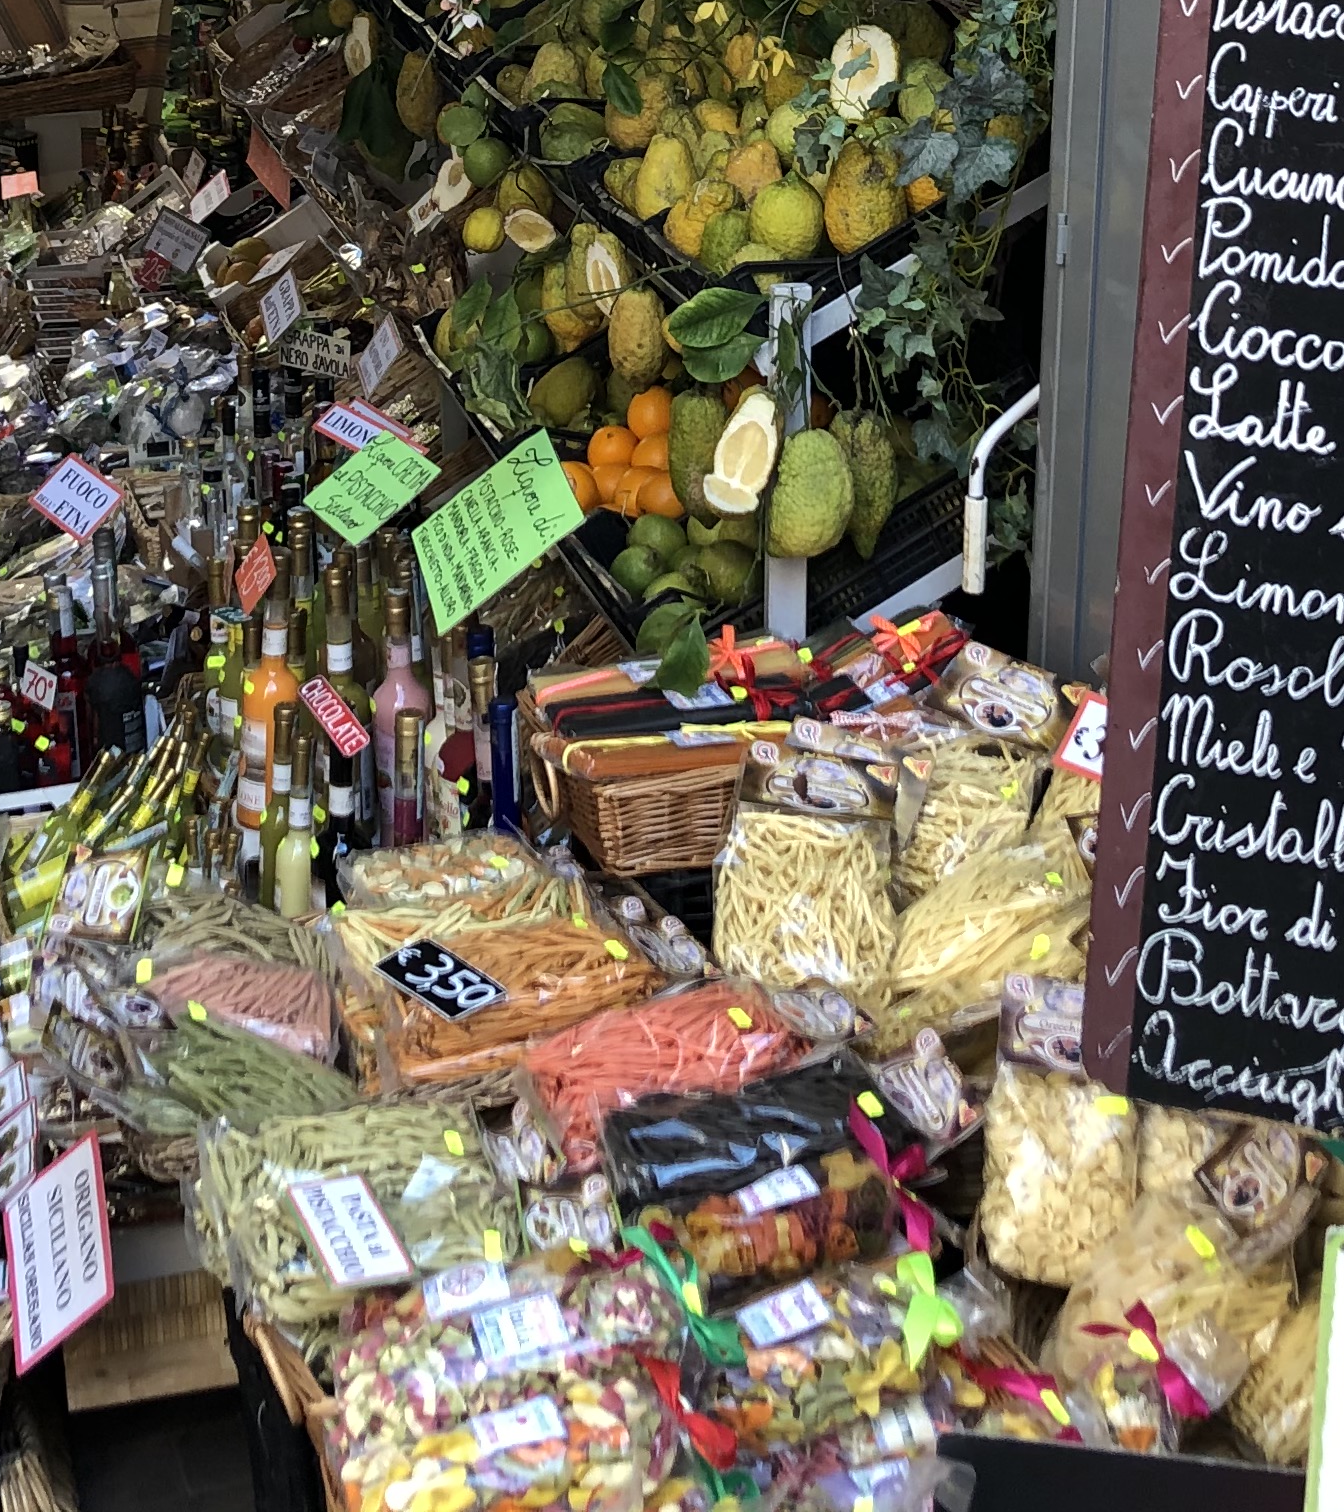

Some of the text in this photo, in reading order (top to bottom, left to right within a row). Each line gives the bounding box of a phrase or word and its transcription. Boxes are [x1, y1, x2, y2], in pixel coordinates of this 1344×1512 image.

[1206, 43, 1340, 138] Capperi
[278, 278, 296, 322] GRAPPA
[280, 346, 309, 367] NERO
[284, 330, 330, 354] GRAPPA
[1188, 362, 1337, 455] Latte
[60, 467, 109, 509] FUOCO
[392, 456, 432, 492] CREMA
[1184, 449, 1323, 534] Vino
[53, 499, 91, 535] ETNA
[25, 667, 54, 702] 70°
[300, 677, 368, 756] CHOCOLATE
[1161, 692, 1283, 781] Miele
[1294, 748, 1317, 784] e
[1155, 852, 1269, 942] Fior
[1285, 881, 1338, 952] di
[404, 952, 496, 1009] 3,50
[47, 1183, 72, 1312] SICILIANO
[74, 1168, 100, 1284] ORIGANO
[302, 1185, 365, 1280] PISTACCHIO
[18, 1192, 44, 1352] SICILIAN OREGANO
